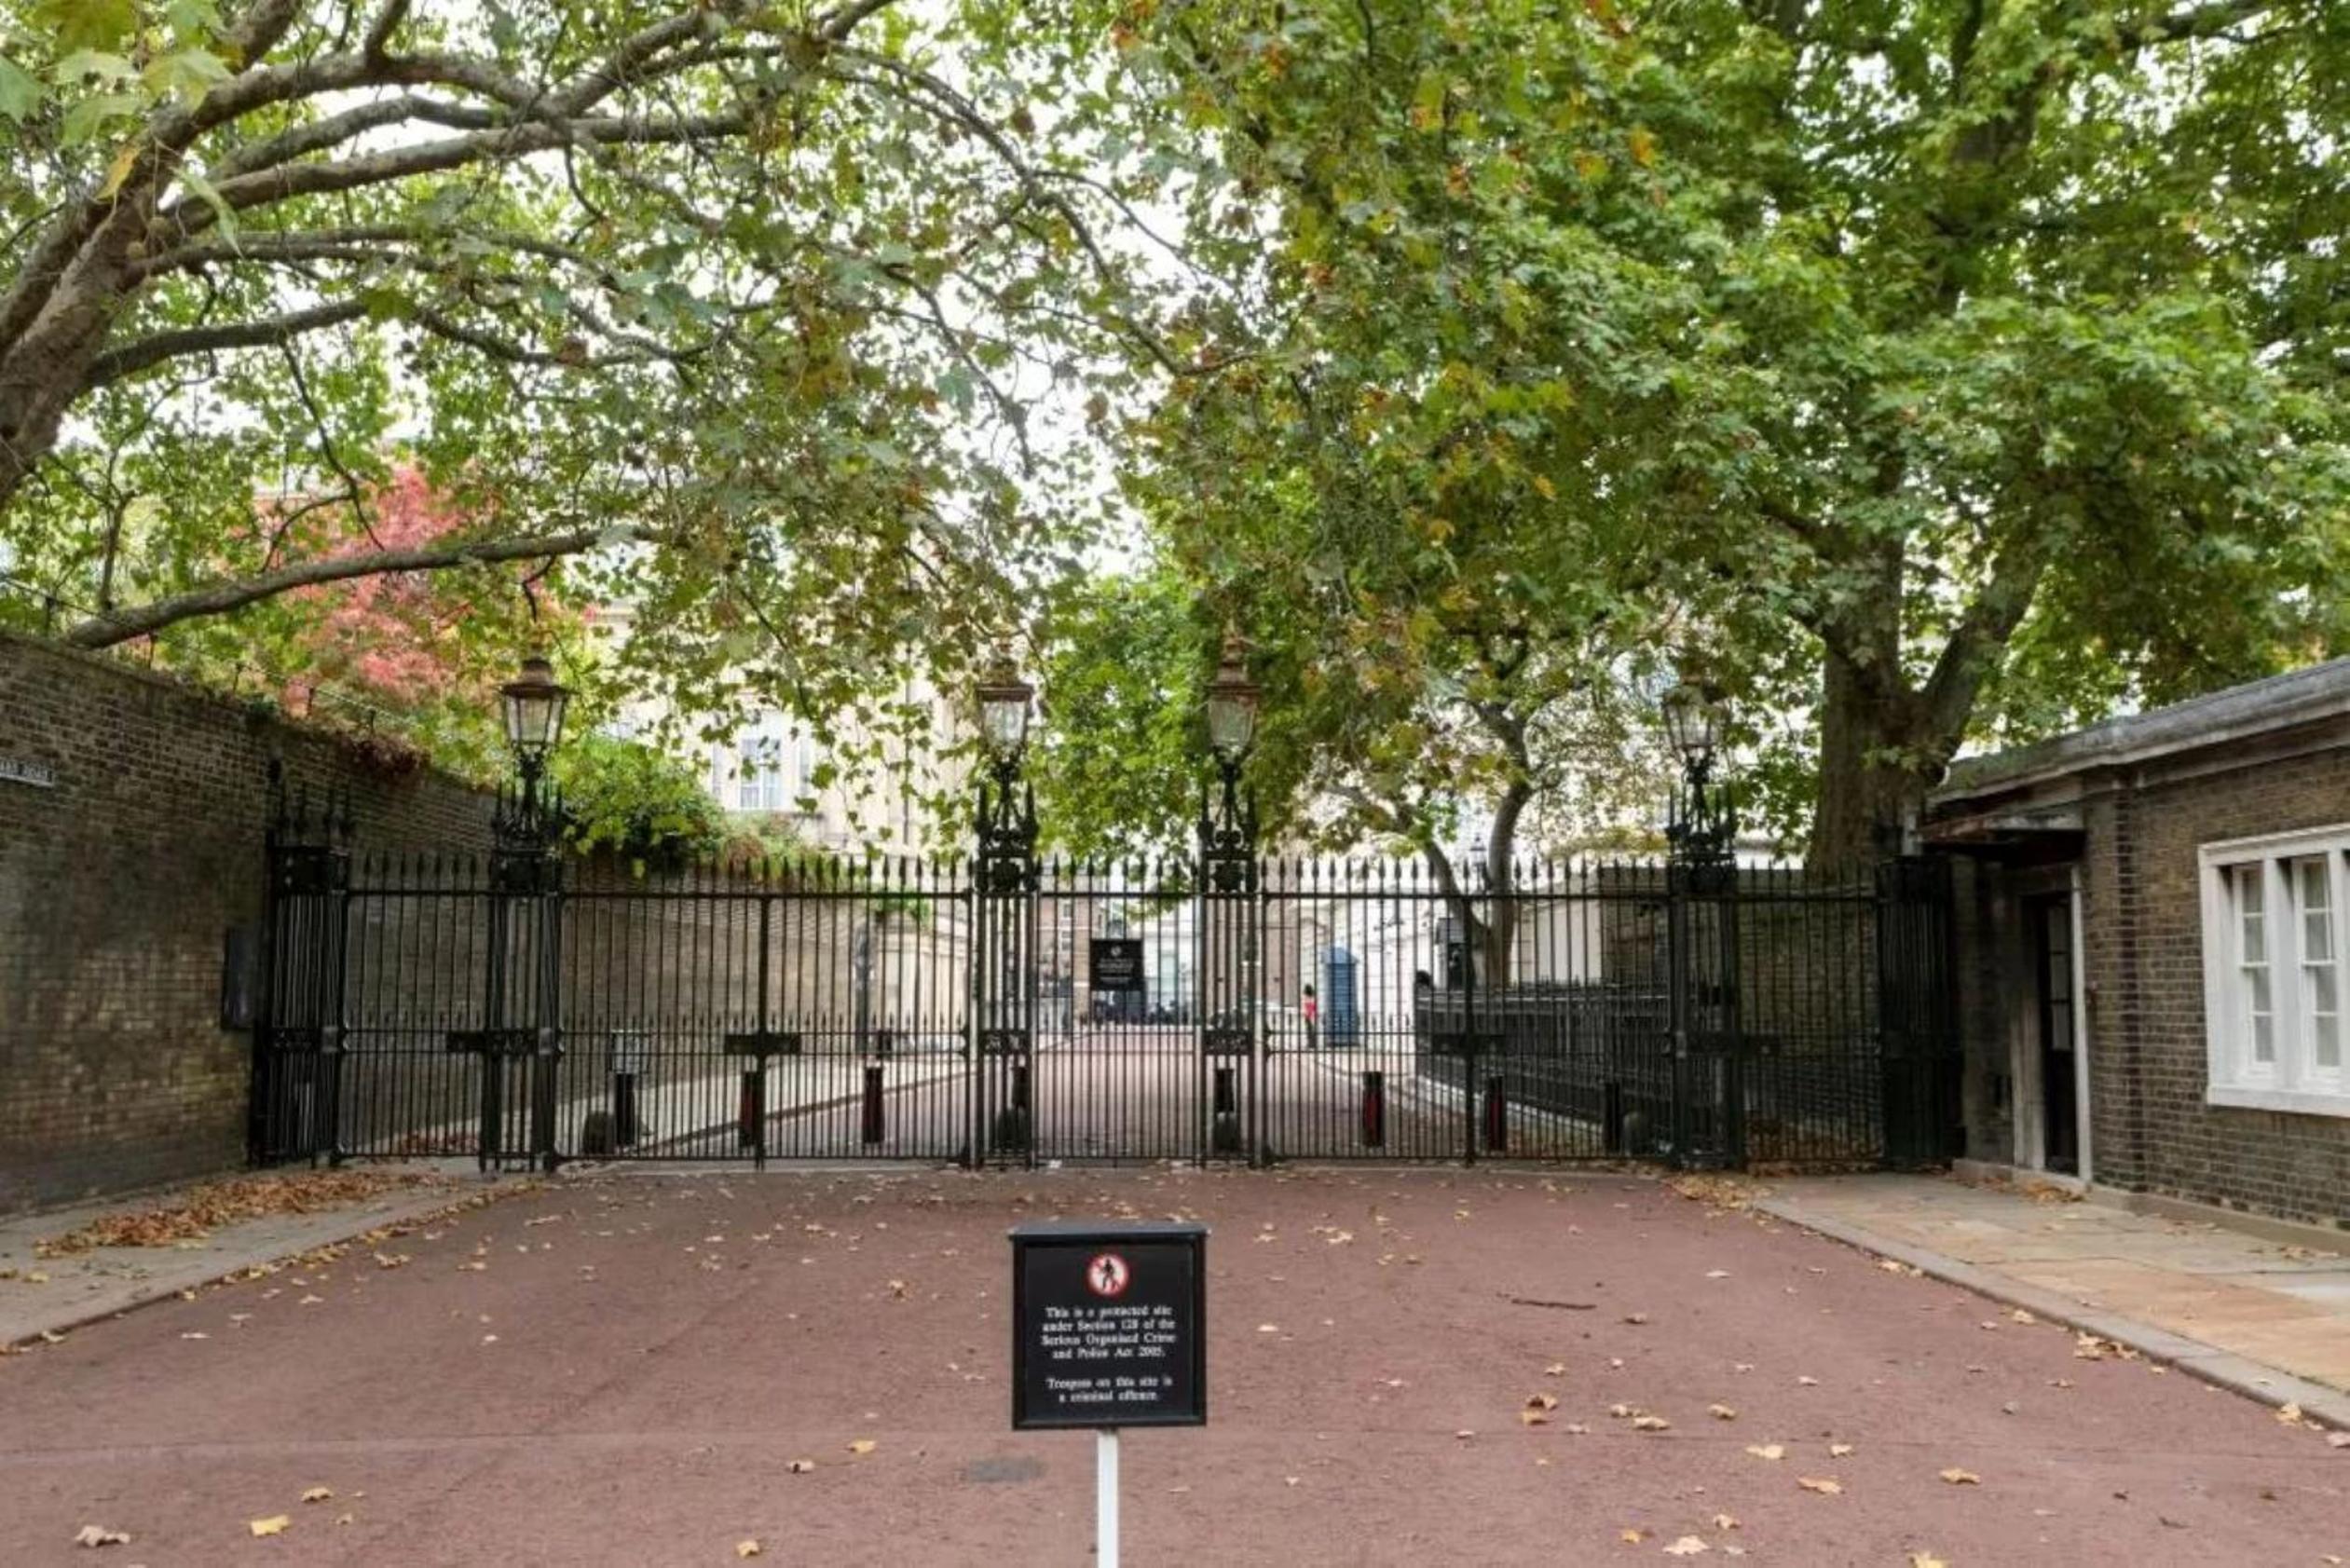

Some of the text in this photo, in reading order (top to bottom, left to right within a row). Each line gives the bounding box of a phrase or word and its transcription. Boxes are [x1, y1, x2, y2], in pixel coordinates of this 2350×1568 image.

[1045, 1306, 1070, 1318] This
[1042, 1320, 1073, 1332] under
[1076, 1319, 1116, 1332] Section
[1142, 1318, 1155, 1329] of
[1157, 1317, 1176, 1329] the
[1041, 1334, 1081, 1346] Serious
[1142, 1332, 1176, 1343] Crime
[1052, 1347, 1073, 1359] and
[1076, 1347, 1109, 1358] Police
[1114, 1347, 1133, 1357] Act
